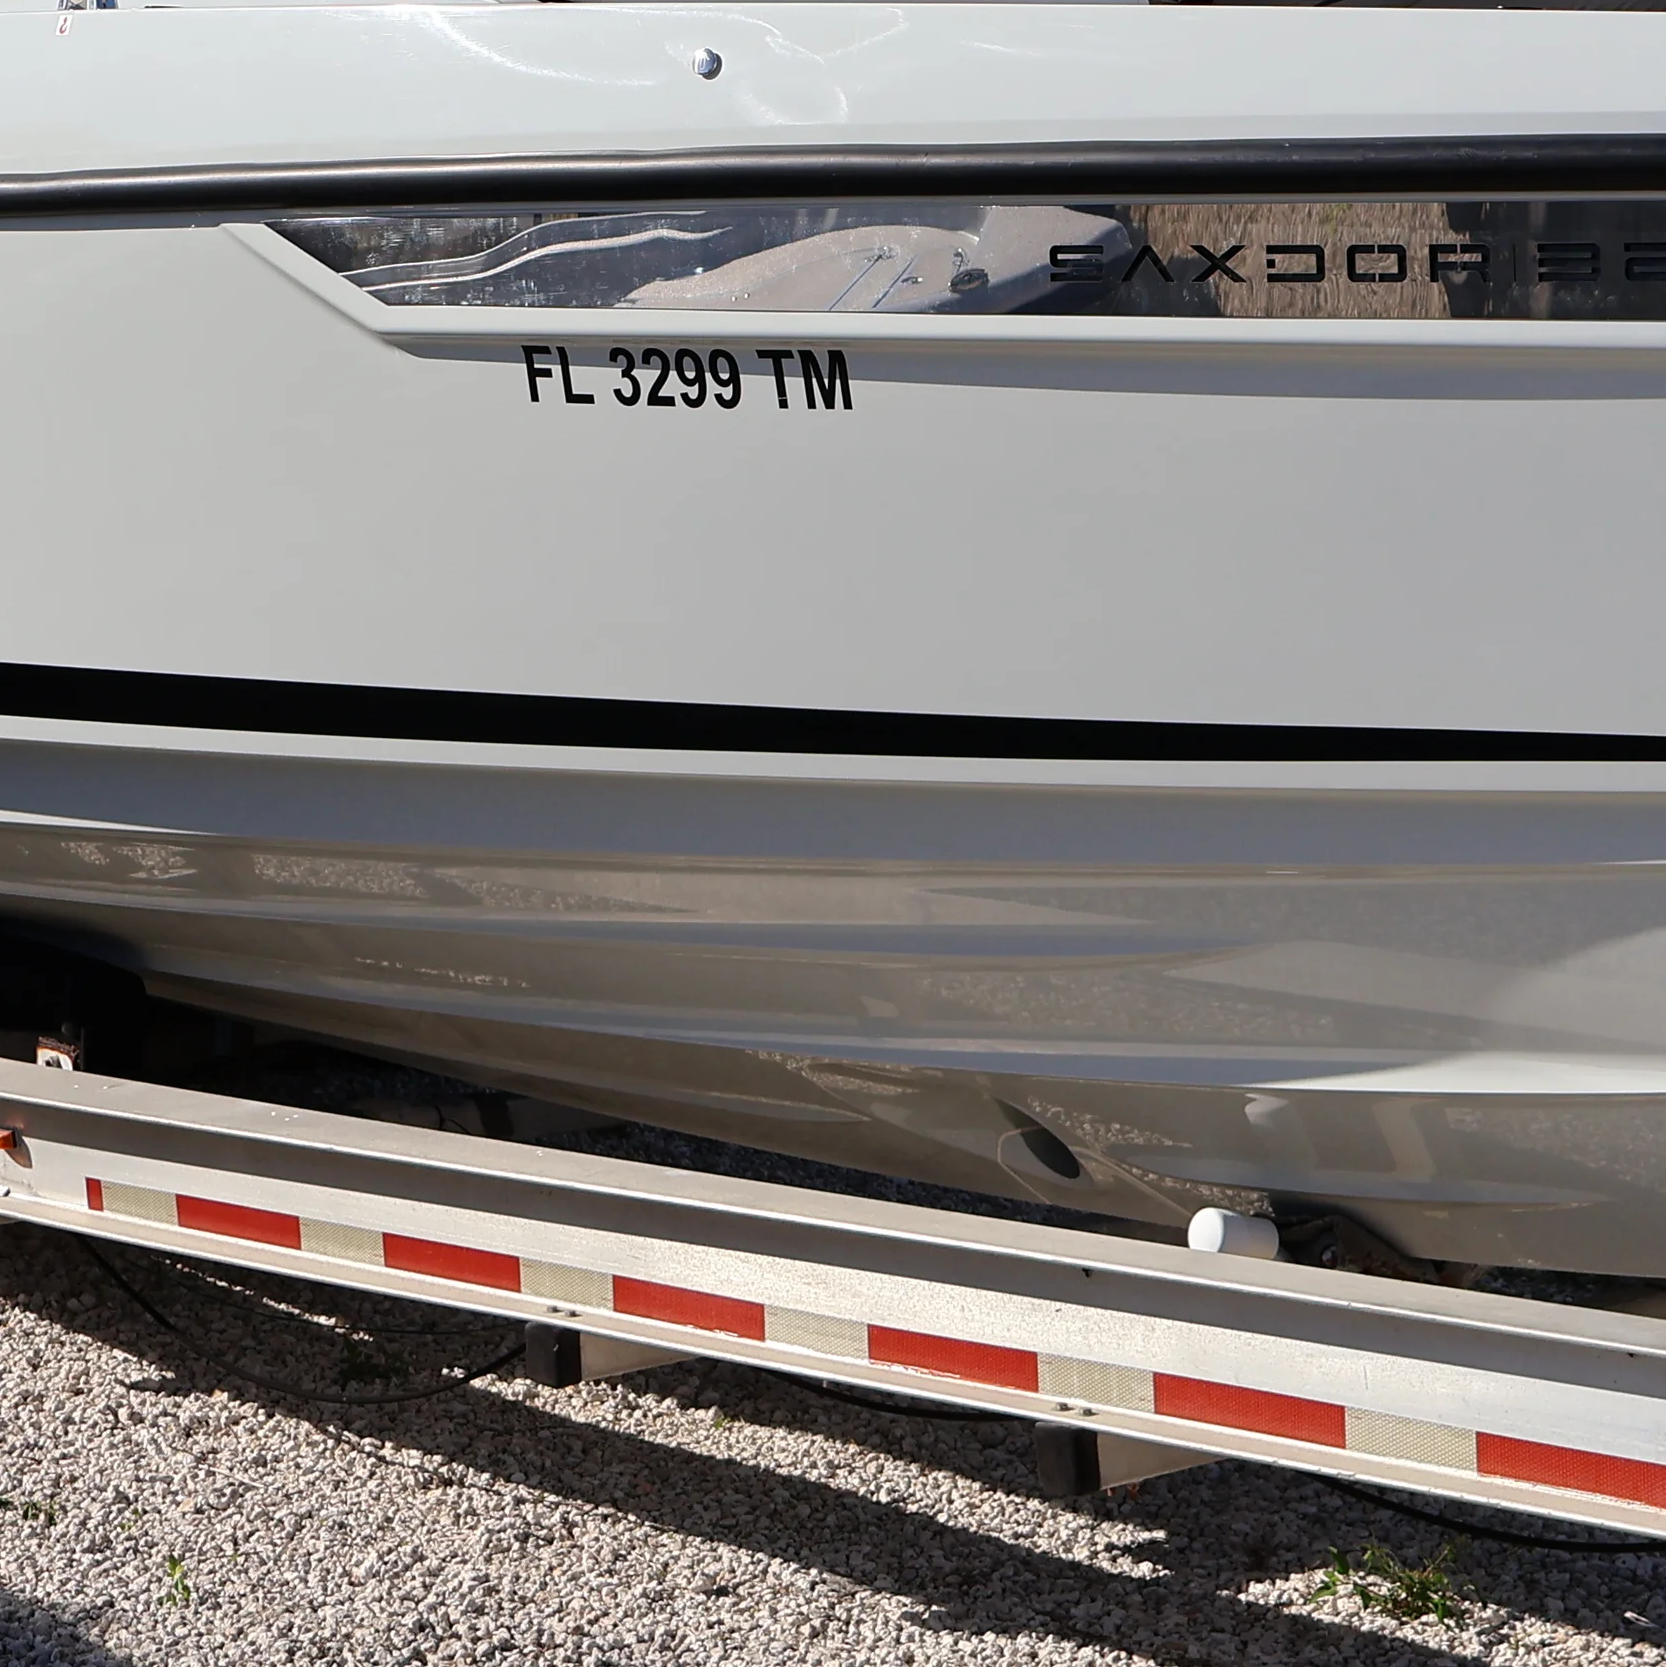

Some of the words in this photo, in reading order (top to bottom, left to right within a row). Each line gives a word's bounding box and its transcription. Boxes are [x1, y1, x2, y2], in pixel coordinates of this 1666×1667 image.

[1048, 242, 1492, 284] SAXDOR
[521, 344, 596, 405] FL
[608, 346, 743, 410] 3299
[755, 348, 854, 411] TM
